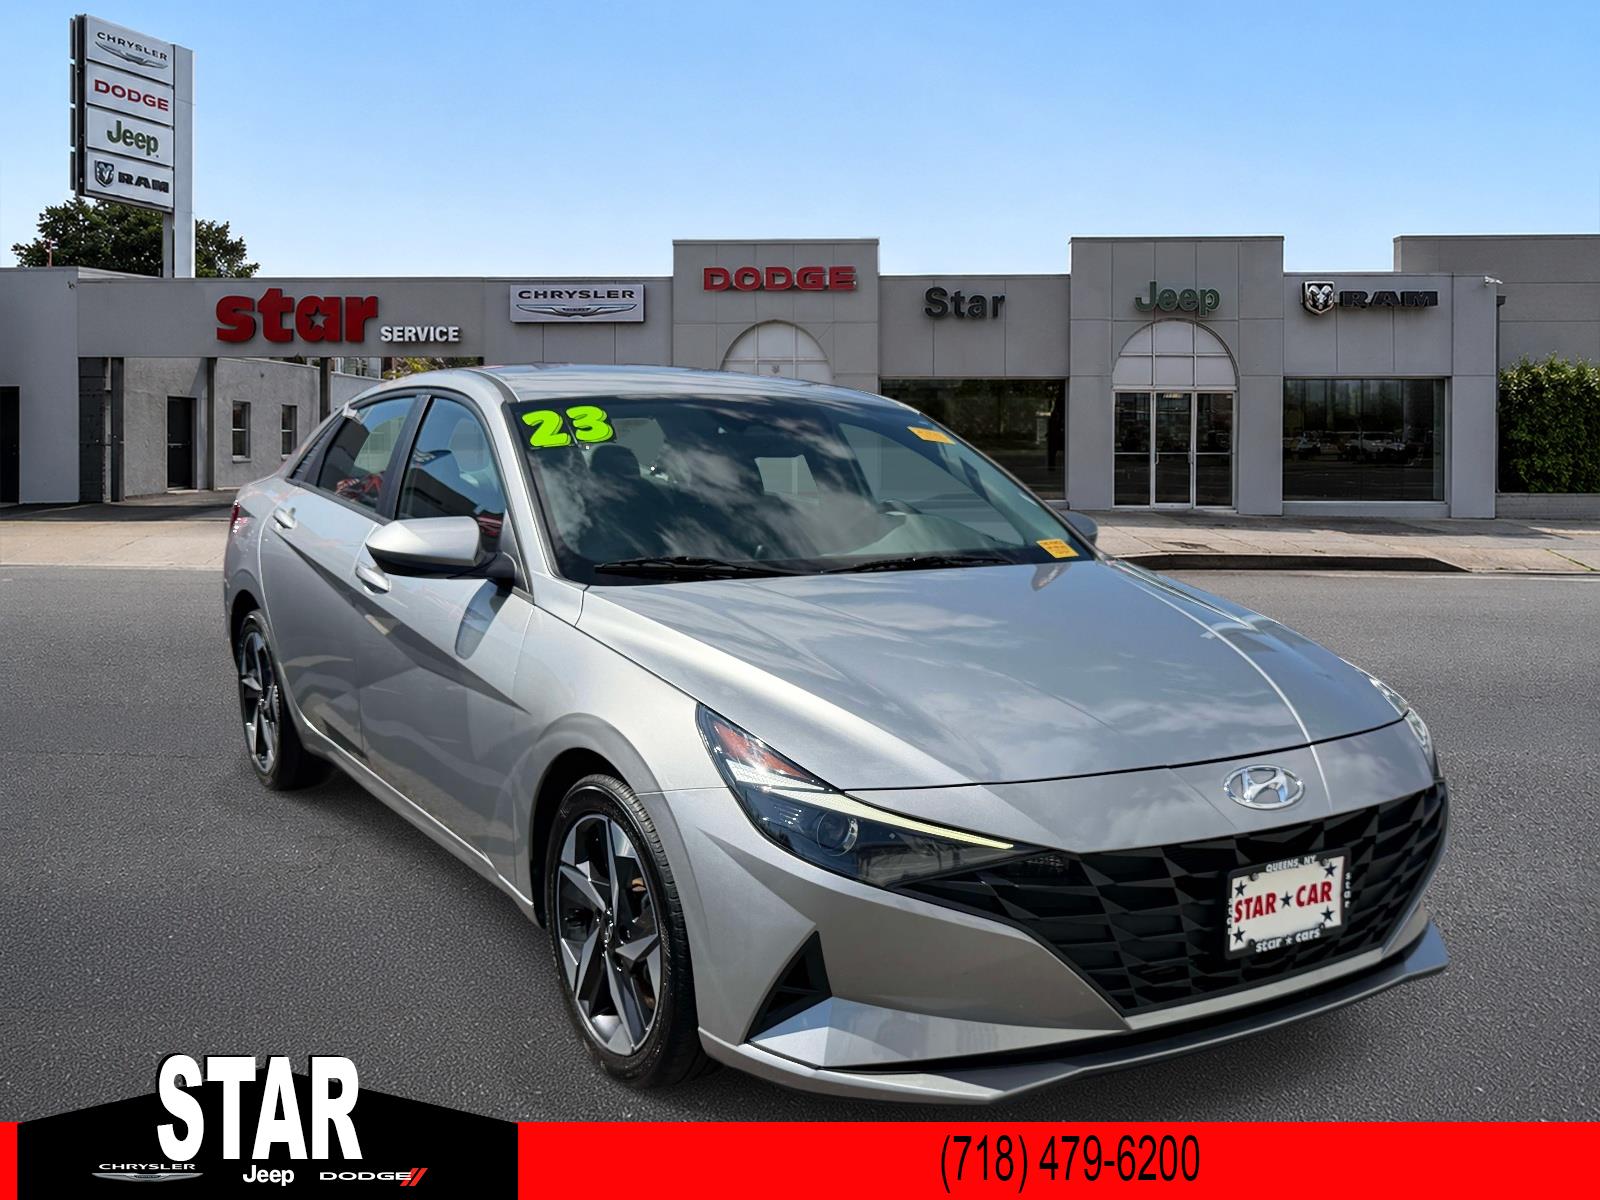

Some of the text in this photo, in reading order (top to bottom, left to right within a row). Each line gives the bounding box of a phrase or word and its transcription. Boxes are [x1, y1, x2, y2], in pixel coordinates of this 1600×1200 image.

[97, 31, 168, 61] CHRYSLER
[94, 79, 169, 111] DODGE
[107, 120, 159, 156] Jeep
[118, 171, 169, 194] RAM
[703, 266, 857, 292] DODGE
[518, 290, 635, 300] CHRYSLER
[924, 286, 1006, 319] Star
[1134, 281, 1221, 317] Jeep
[1339, 290, 1438, 308] RAM
[216, 288, 379, 343] star
[380, 326, 460, 343] SERVICE
[521, 405, 614, 447] 23
[1303, 854, 1317, 864] NY
[1234, 892, 1277, 923] STAR
[1295, 880, 1333, 908] CAR
[1255, 927, 1321, 953] star cars
